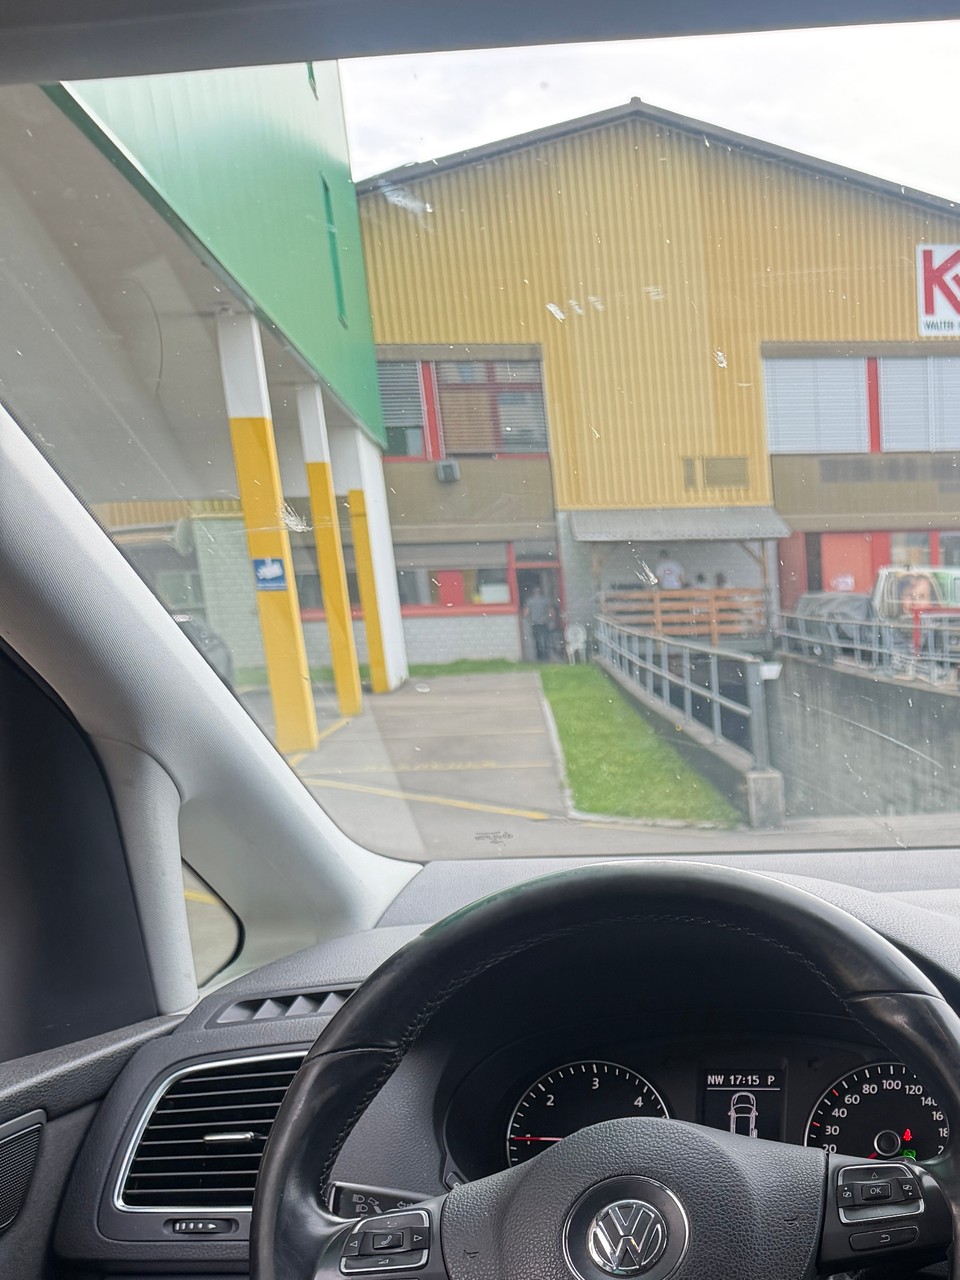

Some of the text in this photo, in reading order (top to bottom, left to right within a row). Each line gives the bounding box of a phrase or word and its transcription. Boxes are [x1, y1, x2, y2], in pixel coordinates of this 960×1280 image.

[591, 1077, 600, 1090] 3
[707, 1074, 776, 1085] NW 17:15 P
[862, 1084, 878, 1094] 80
[882, 1080, 902, 1090] 100
[904, 1085, 923, 1095] 120
[546, 1094, 555, 1106] 2
[633, 1096, 644, 1108] 4
[844, 1094, 860, 1105] 60
[831, 1108, 848, 1118] 40
[931, 1111, 944, 1121] 16
[825, 1125, 840, 1136] 30
[822, 1144, 837, 1154] 20
[869, 1187, 882, 1195] OK
